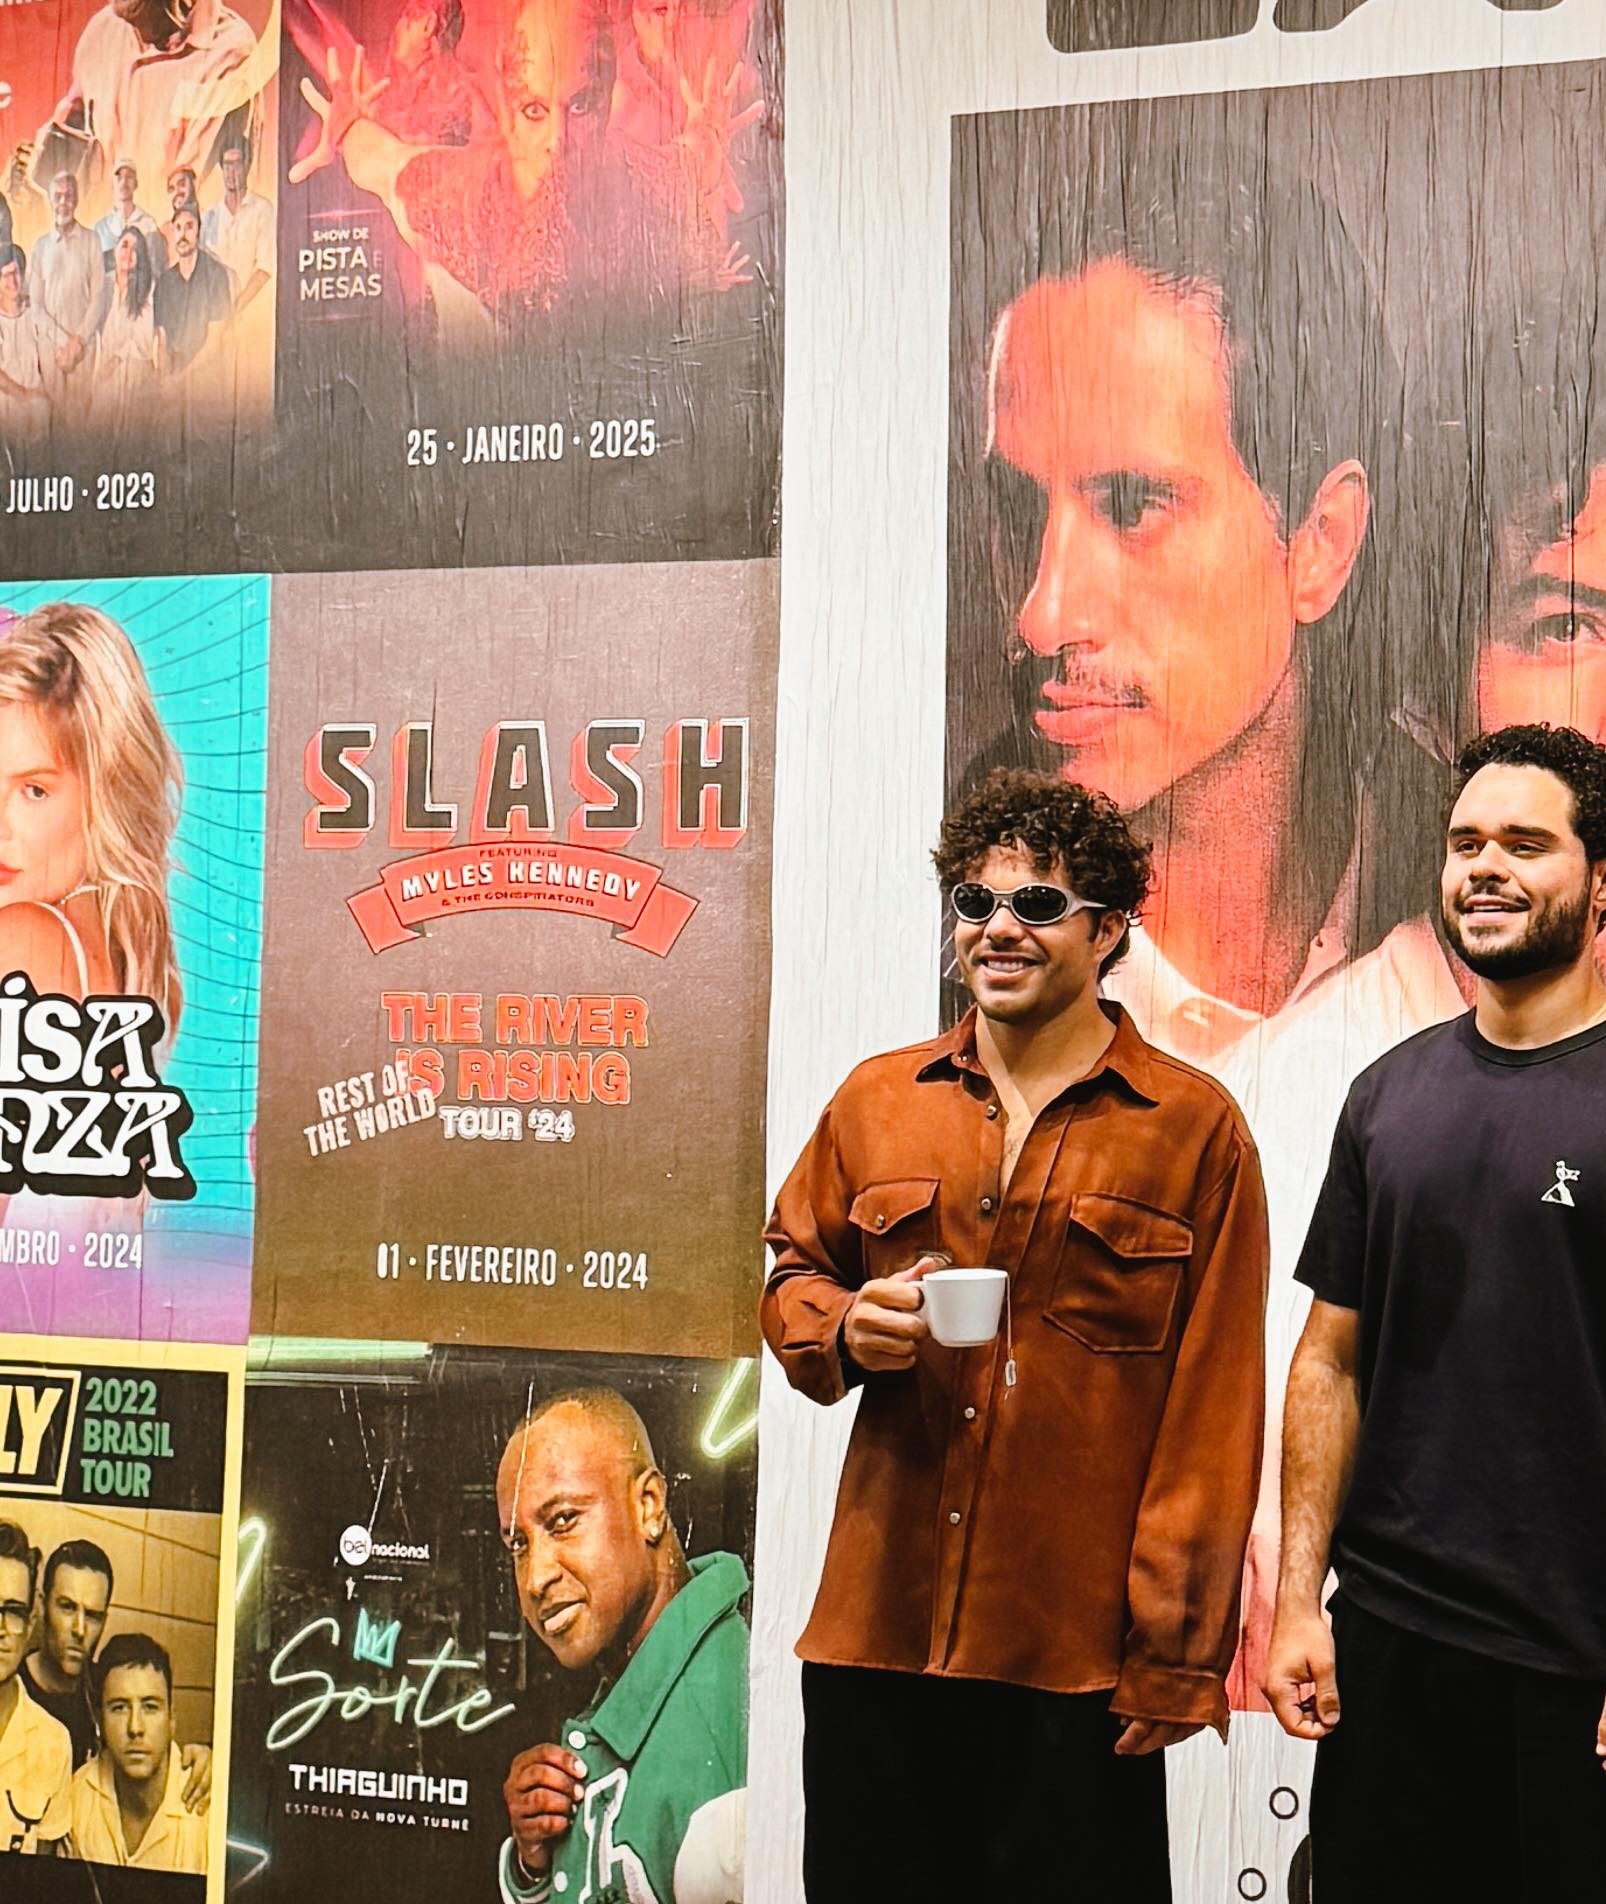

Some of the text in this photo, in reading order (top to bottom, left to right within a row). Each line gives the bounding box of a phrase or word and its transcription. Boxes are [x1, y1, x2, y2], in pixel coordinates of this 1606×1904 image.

[352, 227, 369, 240] DE
[298, 246, 368, 273] PISTA
[299, 274, 383, 302] MESAS
[407, 419, 656, 465] 25 JANEIRO 2025
[6, 471, 155, 513] JULHO 2023
[303, 716, 751, 849] SLASH
[401, 861, 641, 903] MYLES KENNEDY
[381, 992, 650, 1048] THE RIVER
[317, 1059, 413, 1118] REST OF
[457, 1050, 632, 1106] RISING
[303, 1088, 438, 1158] THE WORLD
[438, 1106, 523, 1141] TOUR
[83, 1233, 142, 1269] 2024
[376, 1243, 649, 1290] 01 FEVEREIRO 2024
[84, 1376, 157, 1415] 2022
[82, 1417, 175, 1458] BRASIL
[80, 1458, 152, 1498] TOUR
[266, 1617, 516, 1750] Sorte
[288, 1763, 469, 1807] THIAGUINHO
[285, 1802, 470, 1832] ESTREIA DA NOVA TURNÊ
